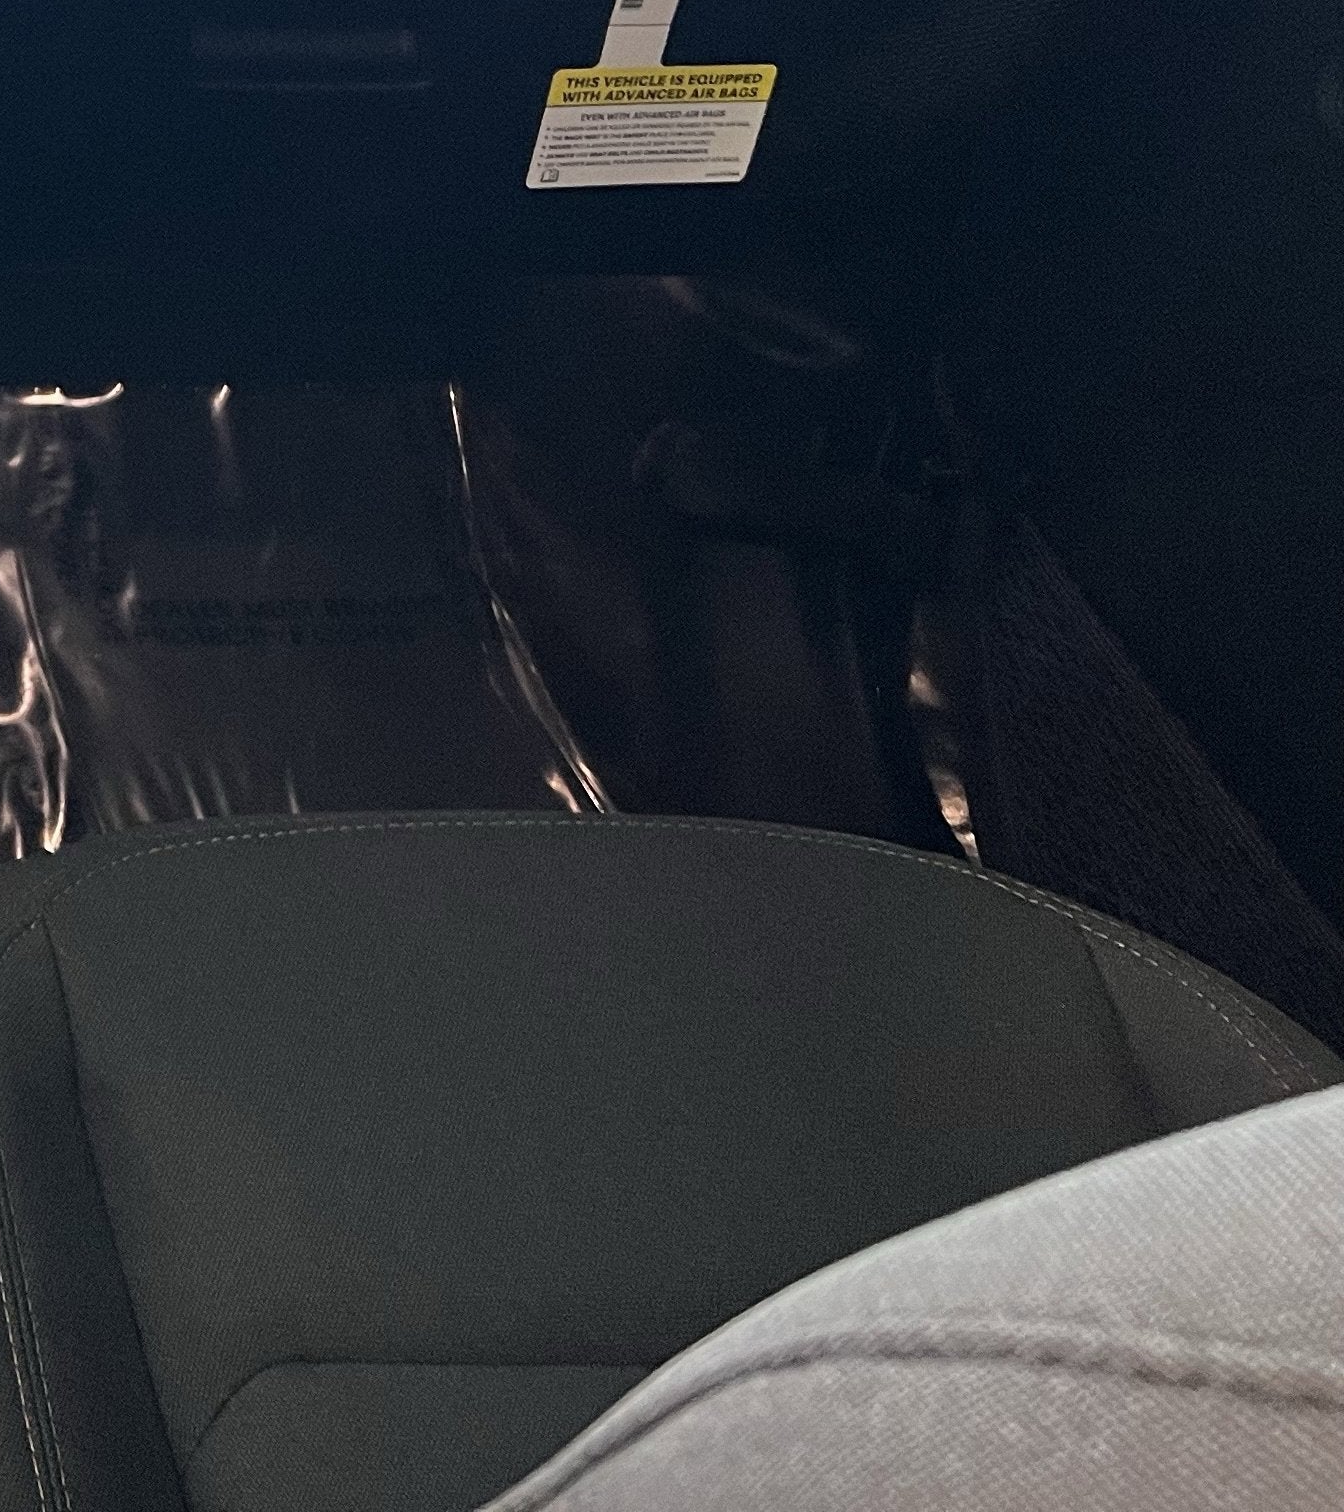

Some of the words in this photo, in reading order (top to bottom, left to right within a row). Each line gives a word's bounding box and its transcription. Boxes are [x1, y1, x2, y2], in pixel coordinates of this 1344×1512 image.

[566, 76, 600, 89] THIS
[604, 74, 667, 88] VEHICLE
[669, 74, 685, 86] IS
[688, 73, 763, 86] EQUIPPED
[562, 90, 601, 103] WITH
[604, 88, 687, 102] ADVANCED
[690, 88, 715, 99] AIR
[718, 87, 759, 98] BAGS
[580, 112, 605, 121] EVEN
[606, 112, 630, 121] WITH
[632, 110, 682, 120] ADVANCED
[682, 110, 700, 118] AIR
[701, 109, 726, 118] BAGS
